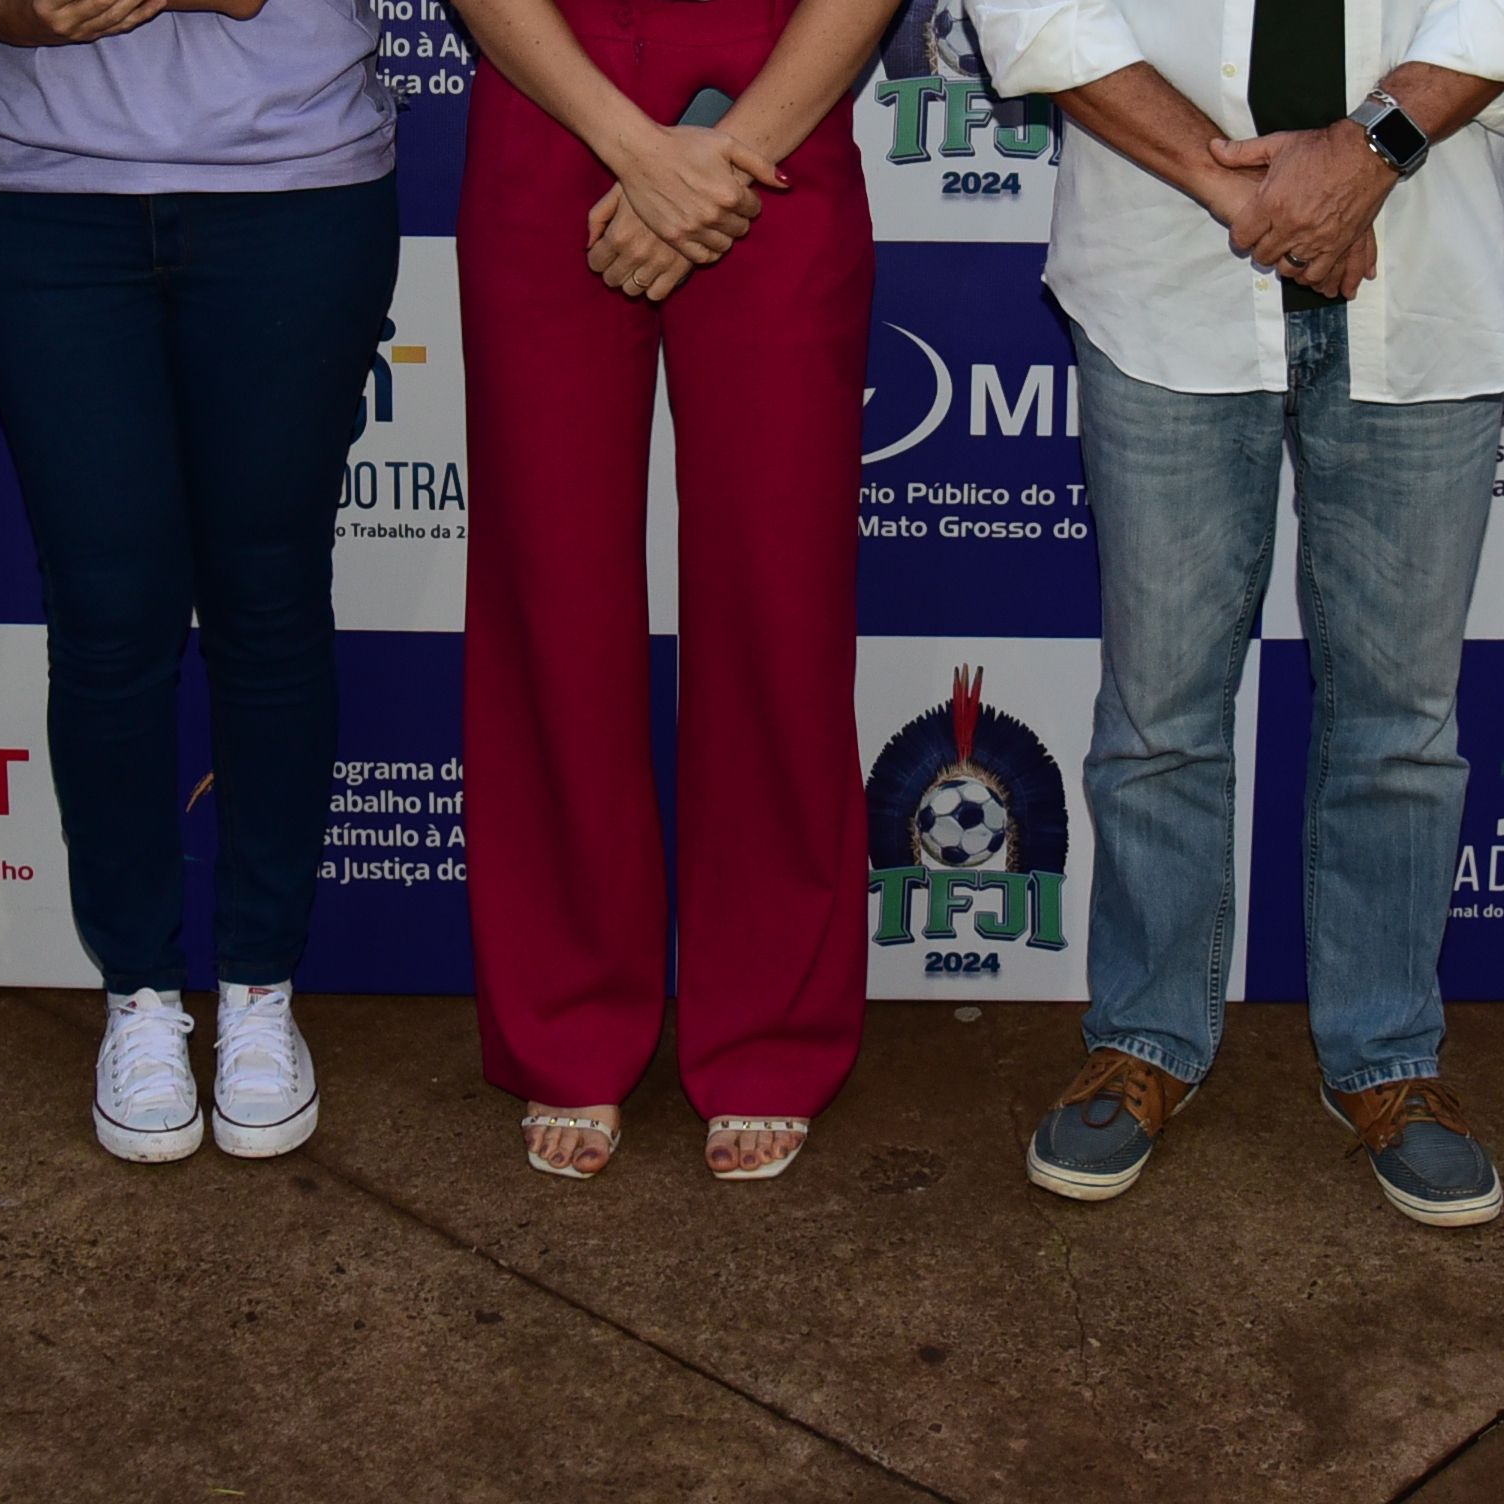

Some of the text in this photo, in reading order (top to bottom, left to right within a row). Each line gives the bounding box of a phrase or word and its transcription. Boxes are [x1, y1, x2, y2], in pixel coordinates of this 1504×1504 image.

[417, 32, 432, 57] à
[429, 69, 464, 94] do
[942, 172, 1021, 194] 2024
[908, 482, 1009, 505] Público
[1021, 484, 1055, 506] do
[351, 523, 425, 538] Trabalho
[431, 524, 450, 539] da
[858, 516, 1087, 538] Mato Grosso do
[333, 761, 433, 785] ograma
[330, 790, 421, 814] abalho
[426, 824, 441, 847] à
[317, 857, 467, 886] a Justiça do
[868, 867, 1068, 952] TFJI
[1483, 904, 1503, 918] do
[925, 952, 1000, 972] 2024
